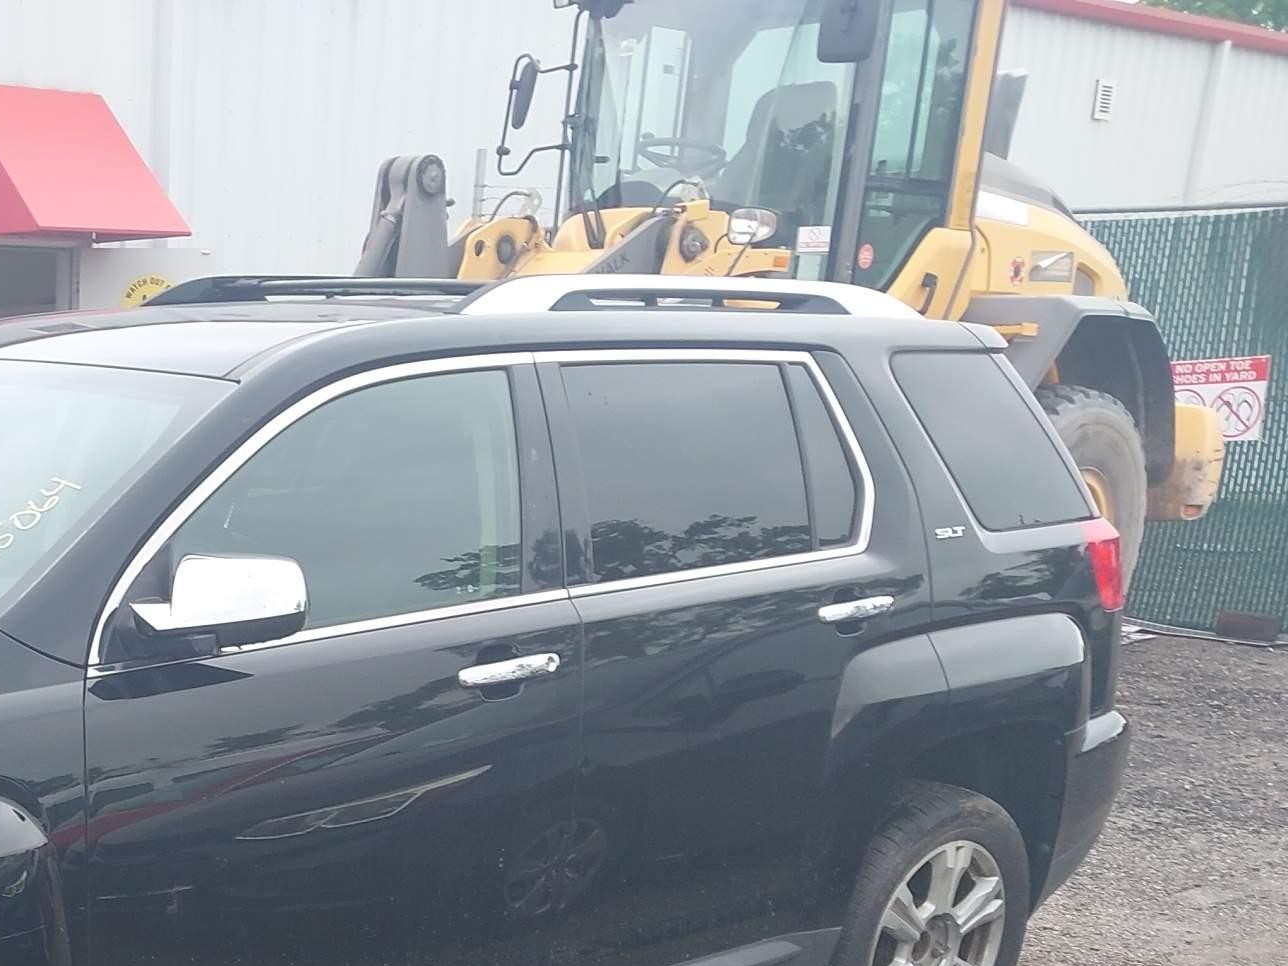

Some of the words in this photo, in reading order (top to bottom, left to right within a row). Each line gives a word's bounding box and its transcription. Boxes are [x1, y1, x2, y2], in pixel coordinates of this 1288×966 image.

[125, 278, 147, 298] WATCH
[150, 277, 166, 287] OUT
[1175, 364, 1192, 374] NO
[1195, 362, 1227, 373] OPEN
[1229, 360, 1253, 371] TOE
[1209, 372, 1222, 383] IN
[1224, 371, 1257, 382] YARD
[934, 526, 965, 539] SLT
